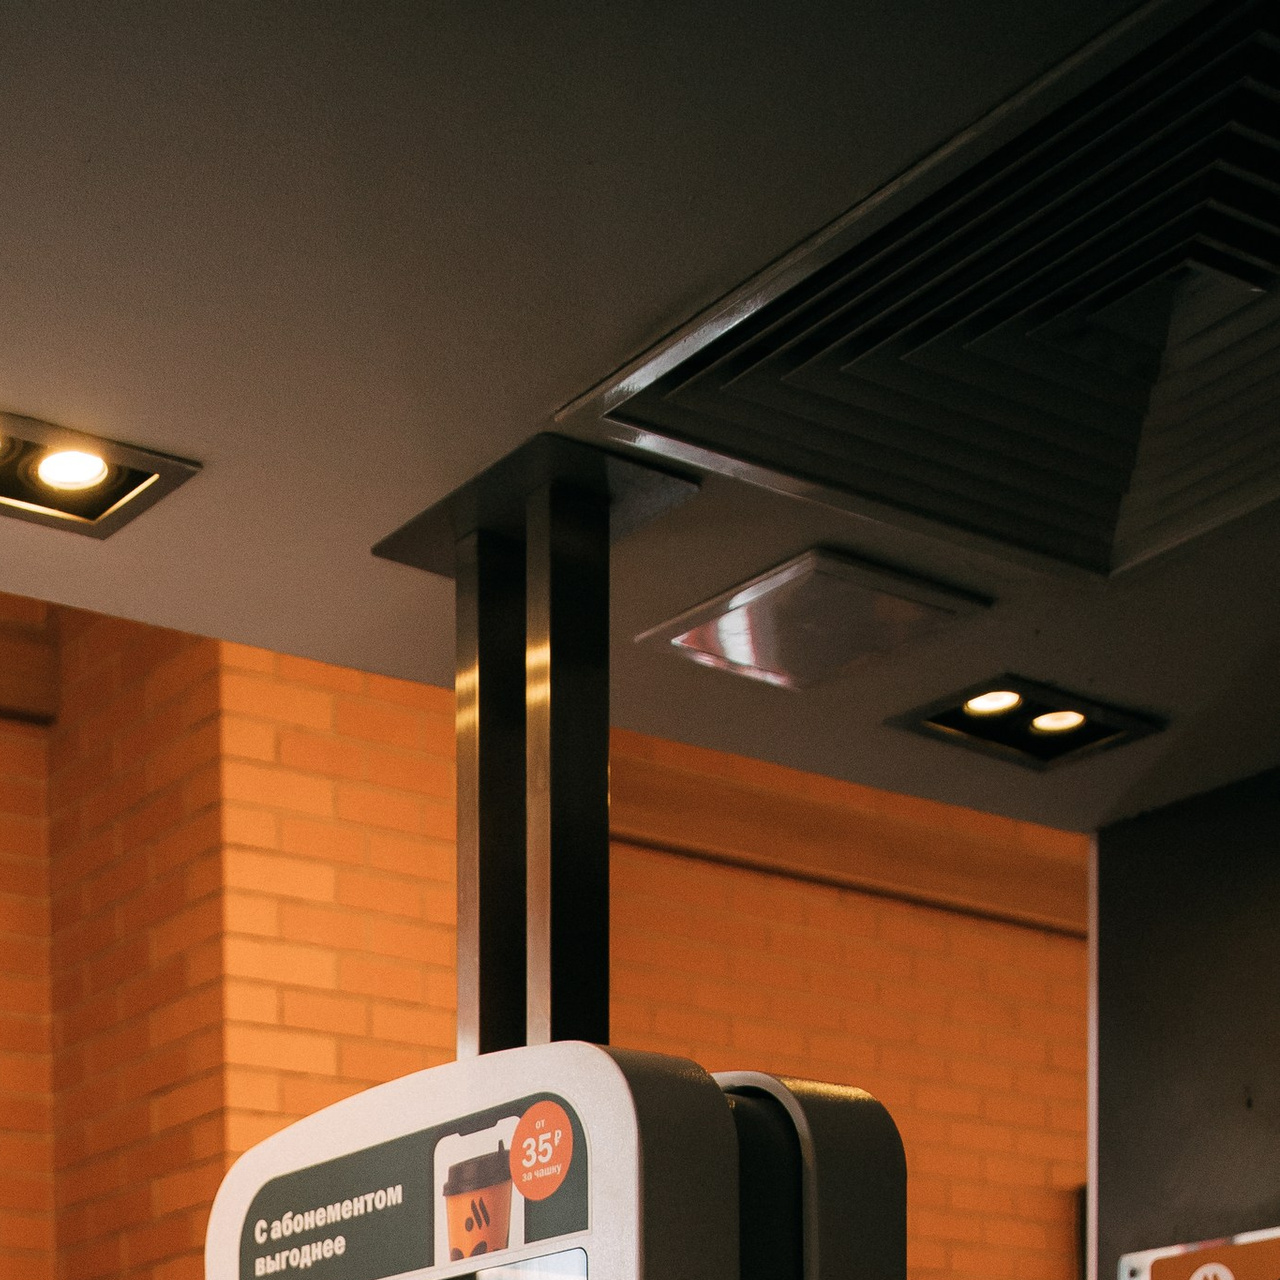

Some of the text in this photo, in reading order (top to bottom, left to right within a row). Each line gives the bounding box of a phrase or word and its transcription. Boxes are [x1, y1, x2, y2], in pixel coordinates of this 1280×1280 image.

[535, 1119, 546, 1130] от
[522, 1163, 562, 1182] за чашку
[254, 1184, 403, 1244] С абонементом
[254, 1235, 346, 1277] выгоднее
